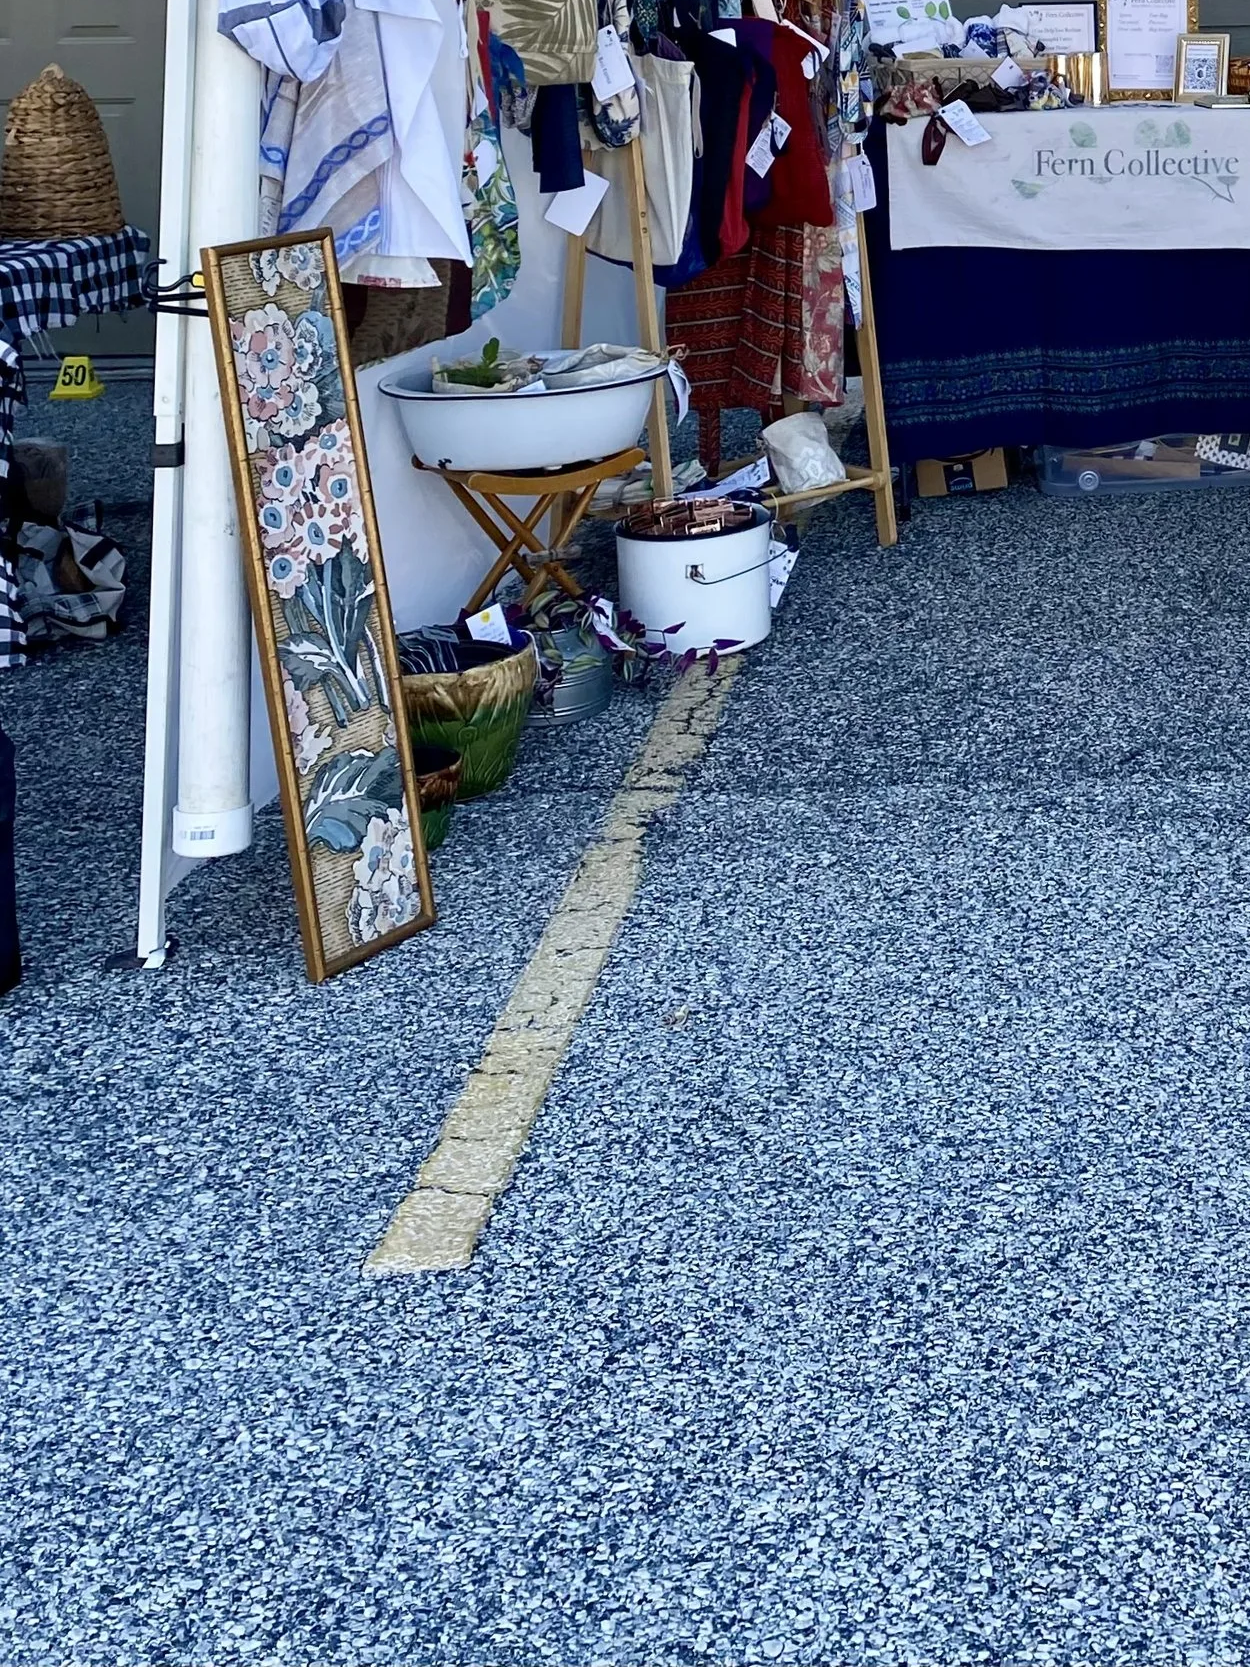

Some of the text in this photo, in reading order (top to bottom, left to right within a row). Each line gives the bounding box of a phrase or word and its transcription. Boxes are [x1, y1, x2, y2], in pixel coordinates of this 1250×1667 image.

[1035, 148, 1239, 176] Fern Collective
[61, 364, 87, 386] 50
